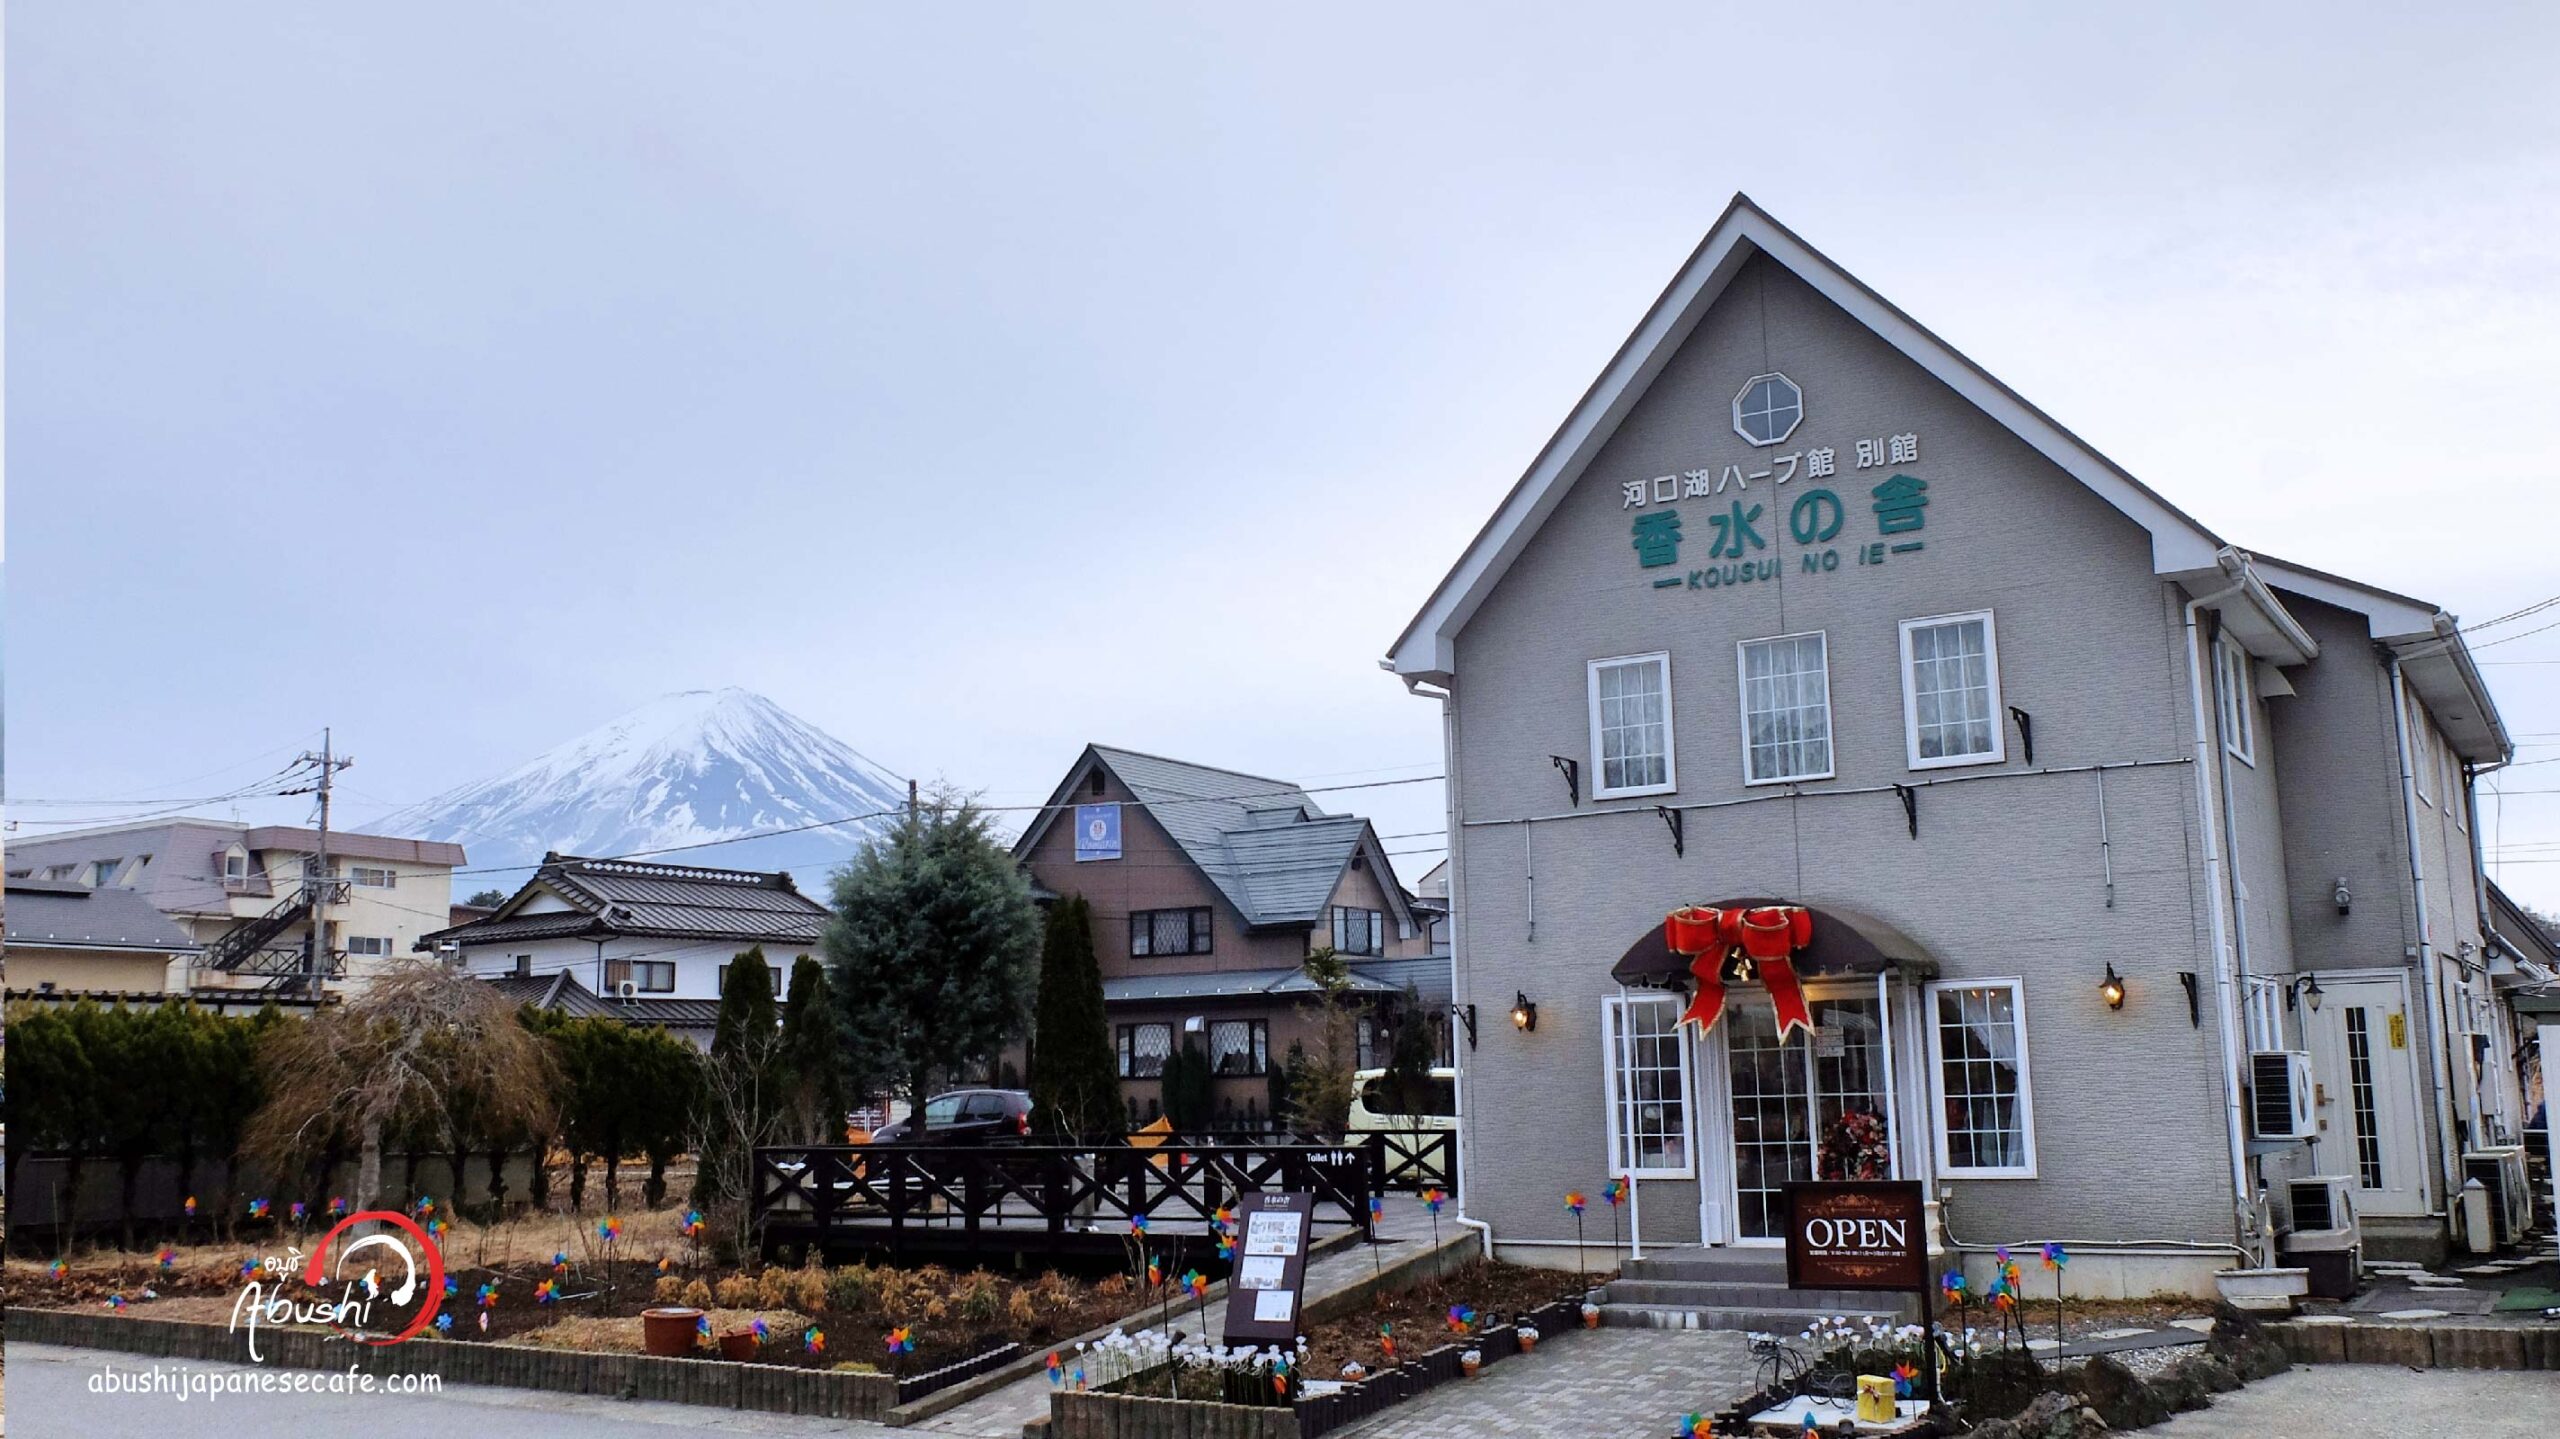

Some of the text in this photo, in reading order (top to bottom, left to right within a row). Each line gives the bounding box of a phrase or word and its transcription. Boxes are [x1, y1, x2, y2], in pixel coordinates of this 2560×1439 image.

[1855, 431, 1919, 469] 別館
[1631, 474, 1929, 568] 香水の舎
[1687, 542, 1885, 590] KOUSUI NO IE
[1306, 1152, 1328, 1162] Toilet
[1805, 1218, 1907, 1248] OPEN
